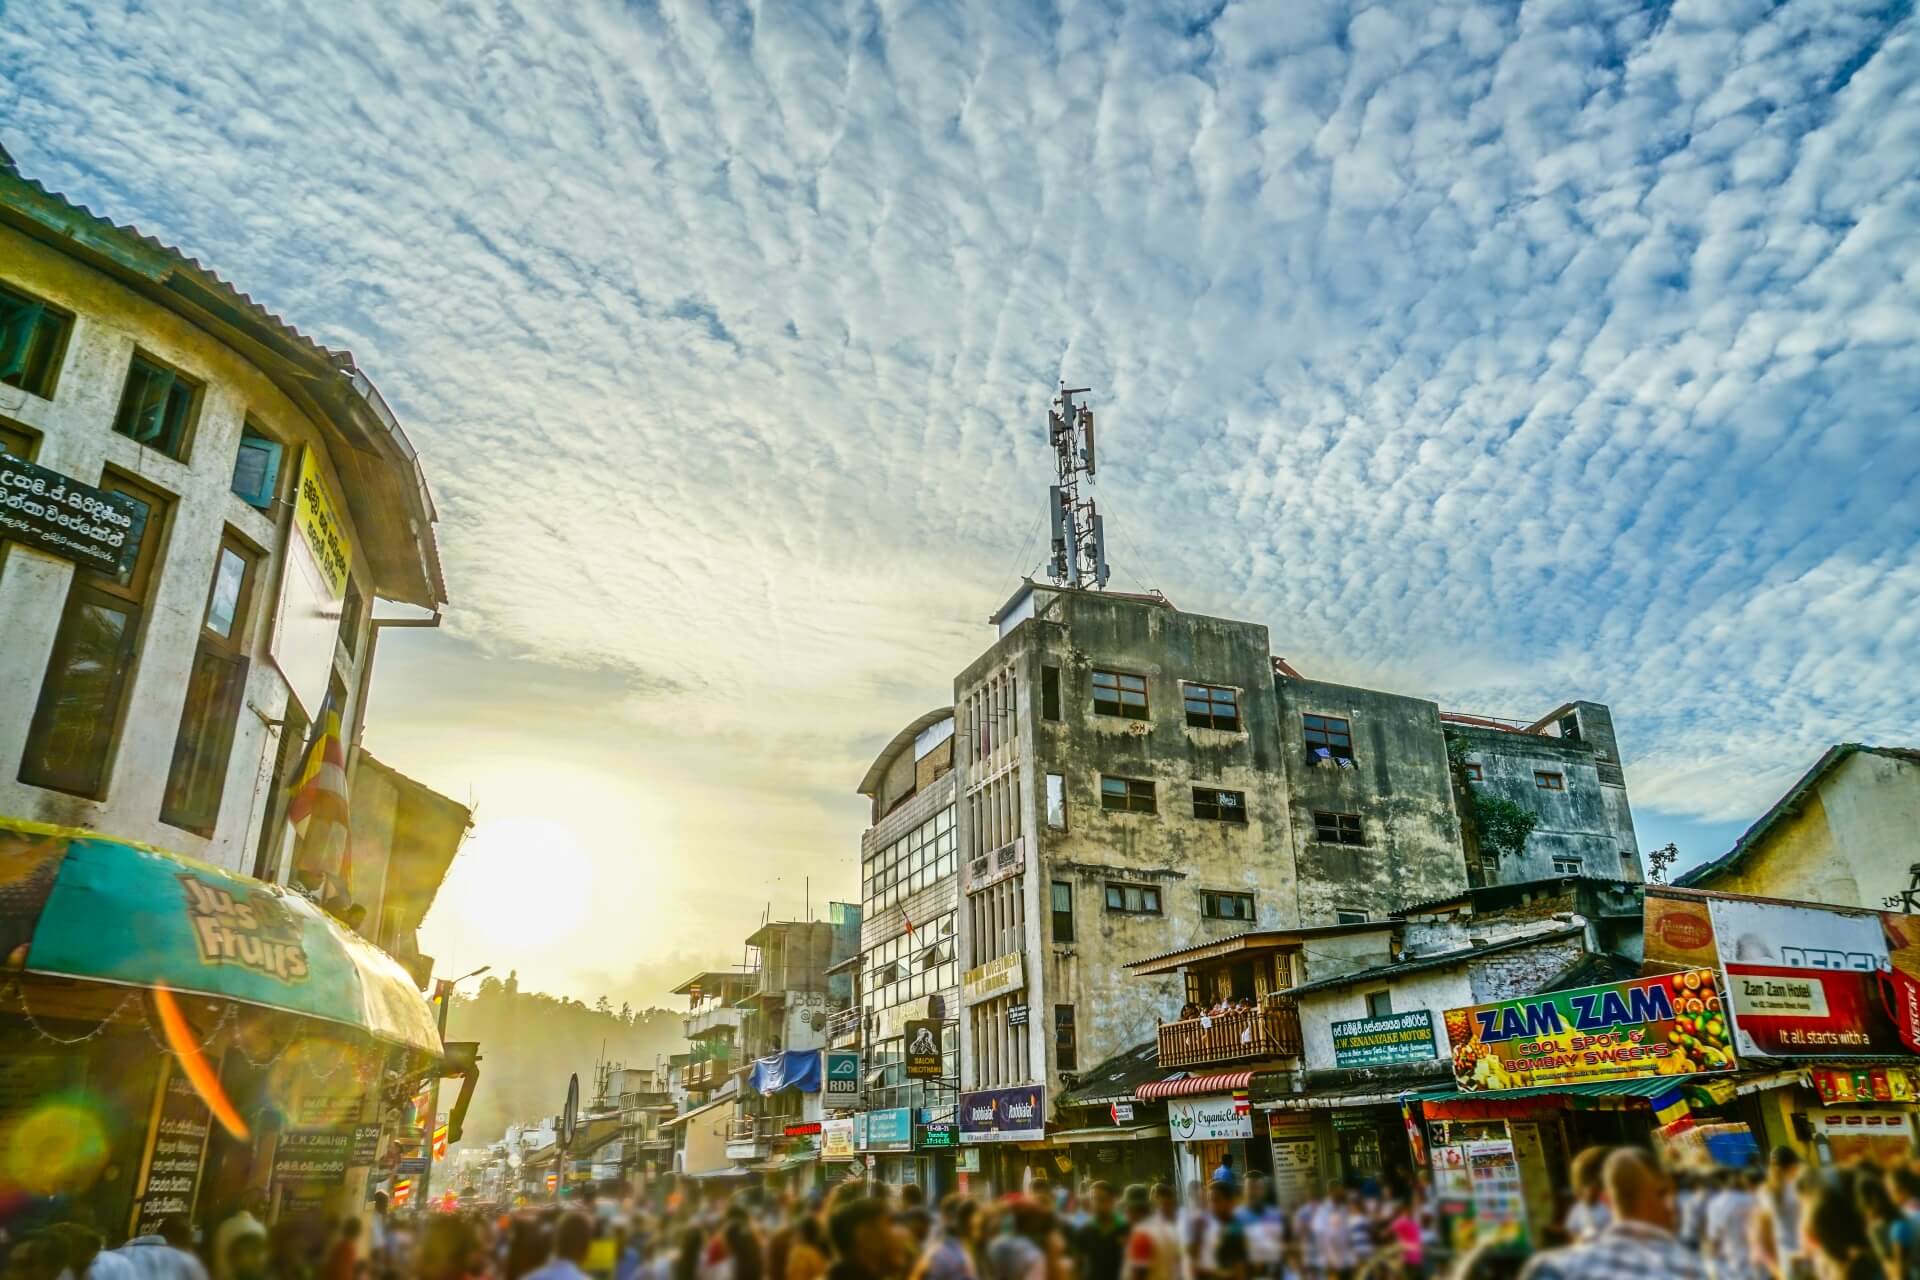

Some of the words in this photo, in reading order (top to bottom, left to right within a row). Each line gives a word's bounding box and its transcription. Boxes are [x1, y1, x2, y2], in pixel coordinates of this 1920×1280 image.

[196, 916, 309, 979] Fruits
[1743, 980, 1764, 996] Zam
[1765, 981, 1785, 997] Zam
[1787, 983, 1811, 998] Hotel
[1475, 1001, 1563, 1043] ZAM
[1570, 984, 1676, 1032] ZAM
[1350, 1032, 1398, 1048] SENANAYAKE
[1400, 1028, 1432, 1042] MOTORS
[1518, 1038, 1570, 1056] COOL
[1573, 1031, 1621, 1050] SPOT
[1627, 1029, 1644, 1043] &
[1779, 1030, 1789, 1043] It
[1791, 1030, 1805, 1044] all
[1807, 1031, 1838, 1044] starts
[1839, 1031, 1862, 1045] with
[1862, 1035, 1870, 1044] a
[1503, 1054, 1578, 1073] BOMBAY
[1583, 1042, 1669, 1067] SWEETS
[829, 1080, 855, 1092] RDB
[1198, 1109, 1227, 1125] Organic
